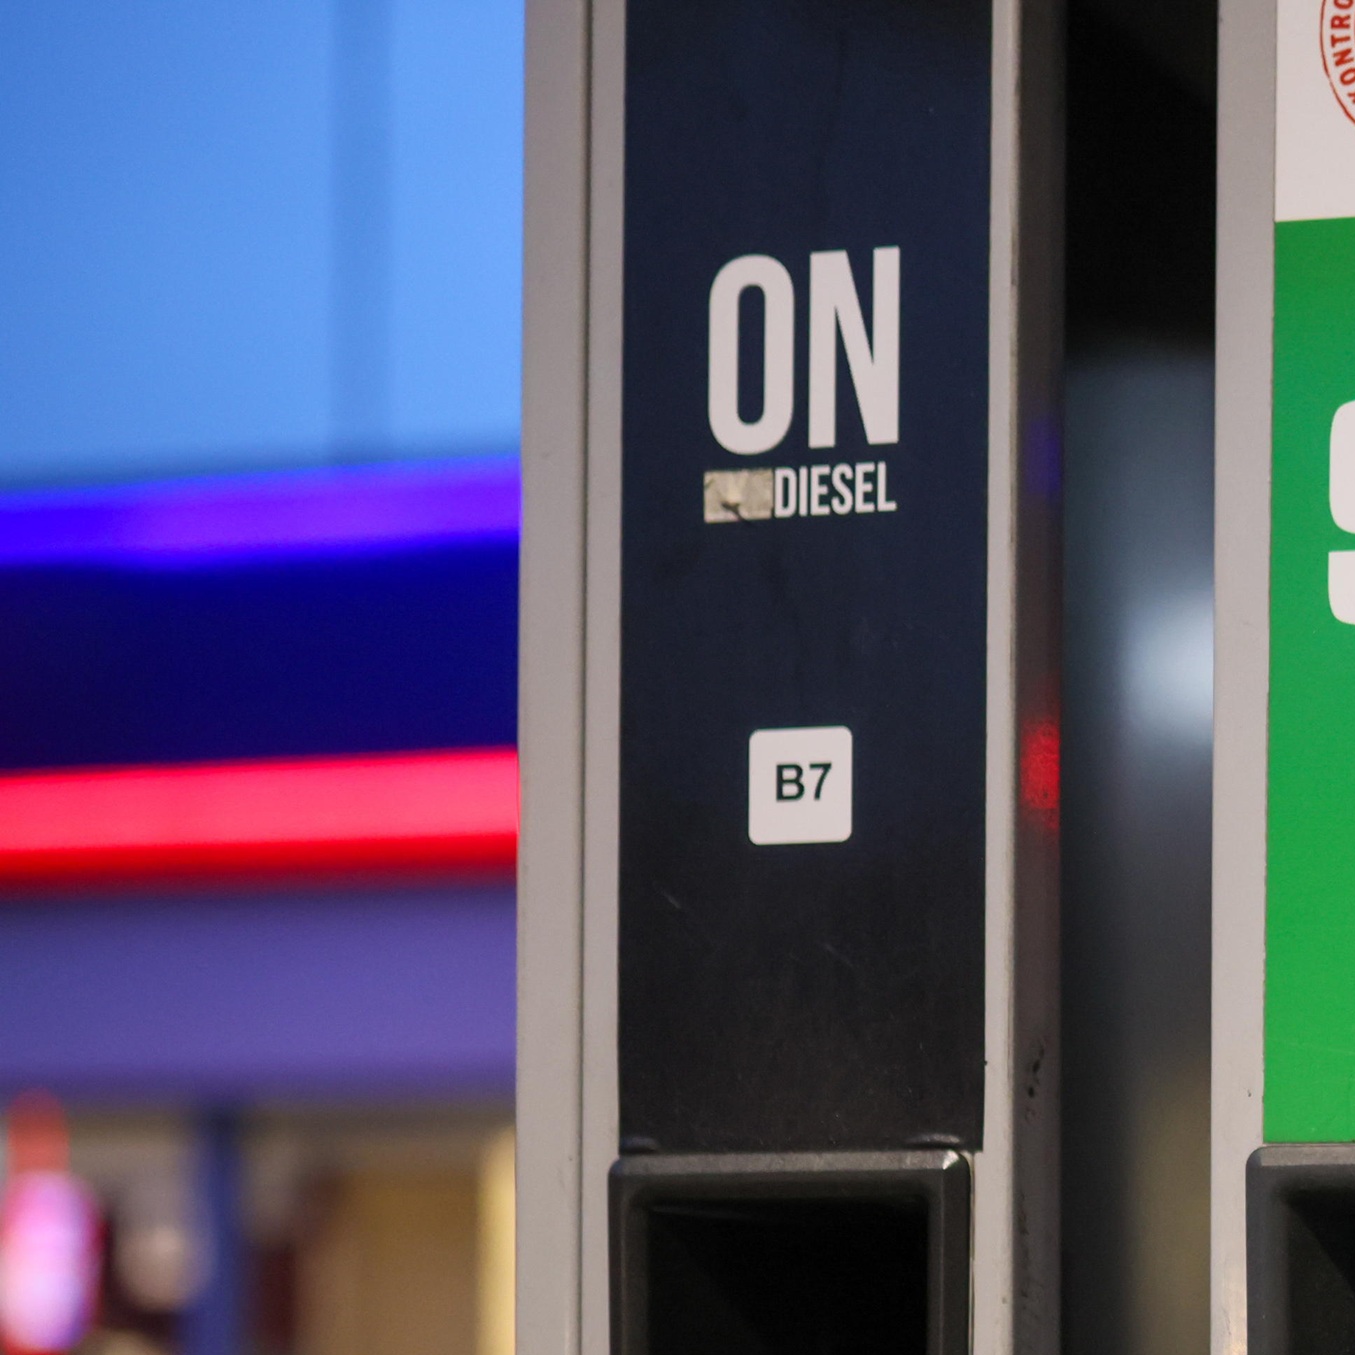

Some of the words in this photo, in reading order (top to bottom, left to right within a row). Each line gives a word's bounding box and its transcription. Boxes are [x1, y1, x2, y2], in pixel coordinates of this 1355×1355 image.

[708, 246, 899, 456] ON
[773, 461, 898, 519] DIESEL
[775, 762, 832, 802] B7
